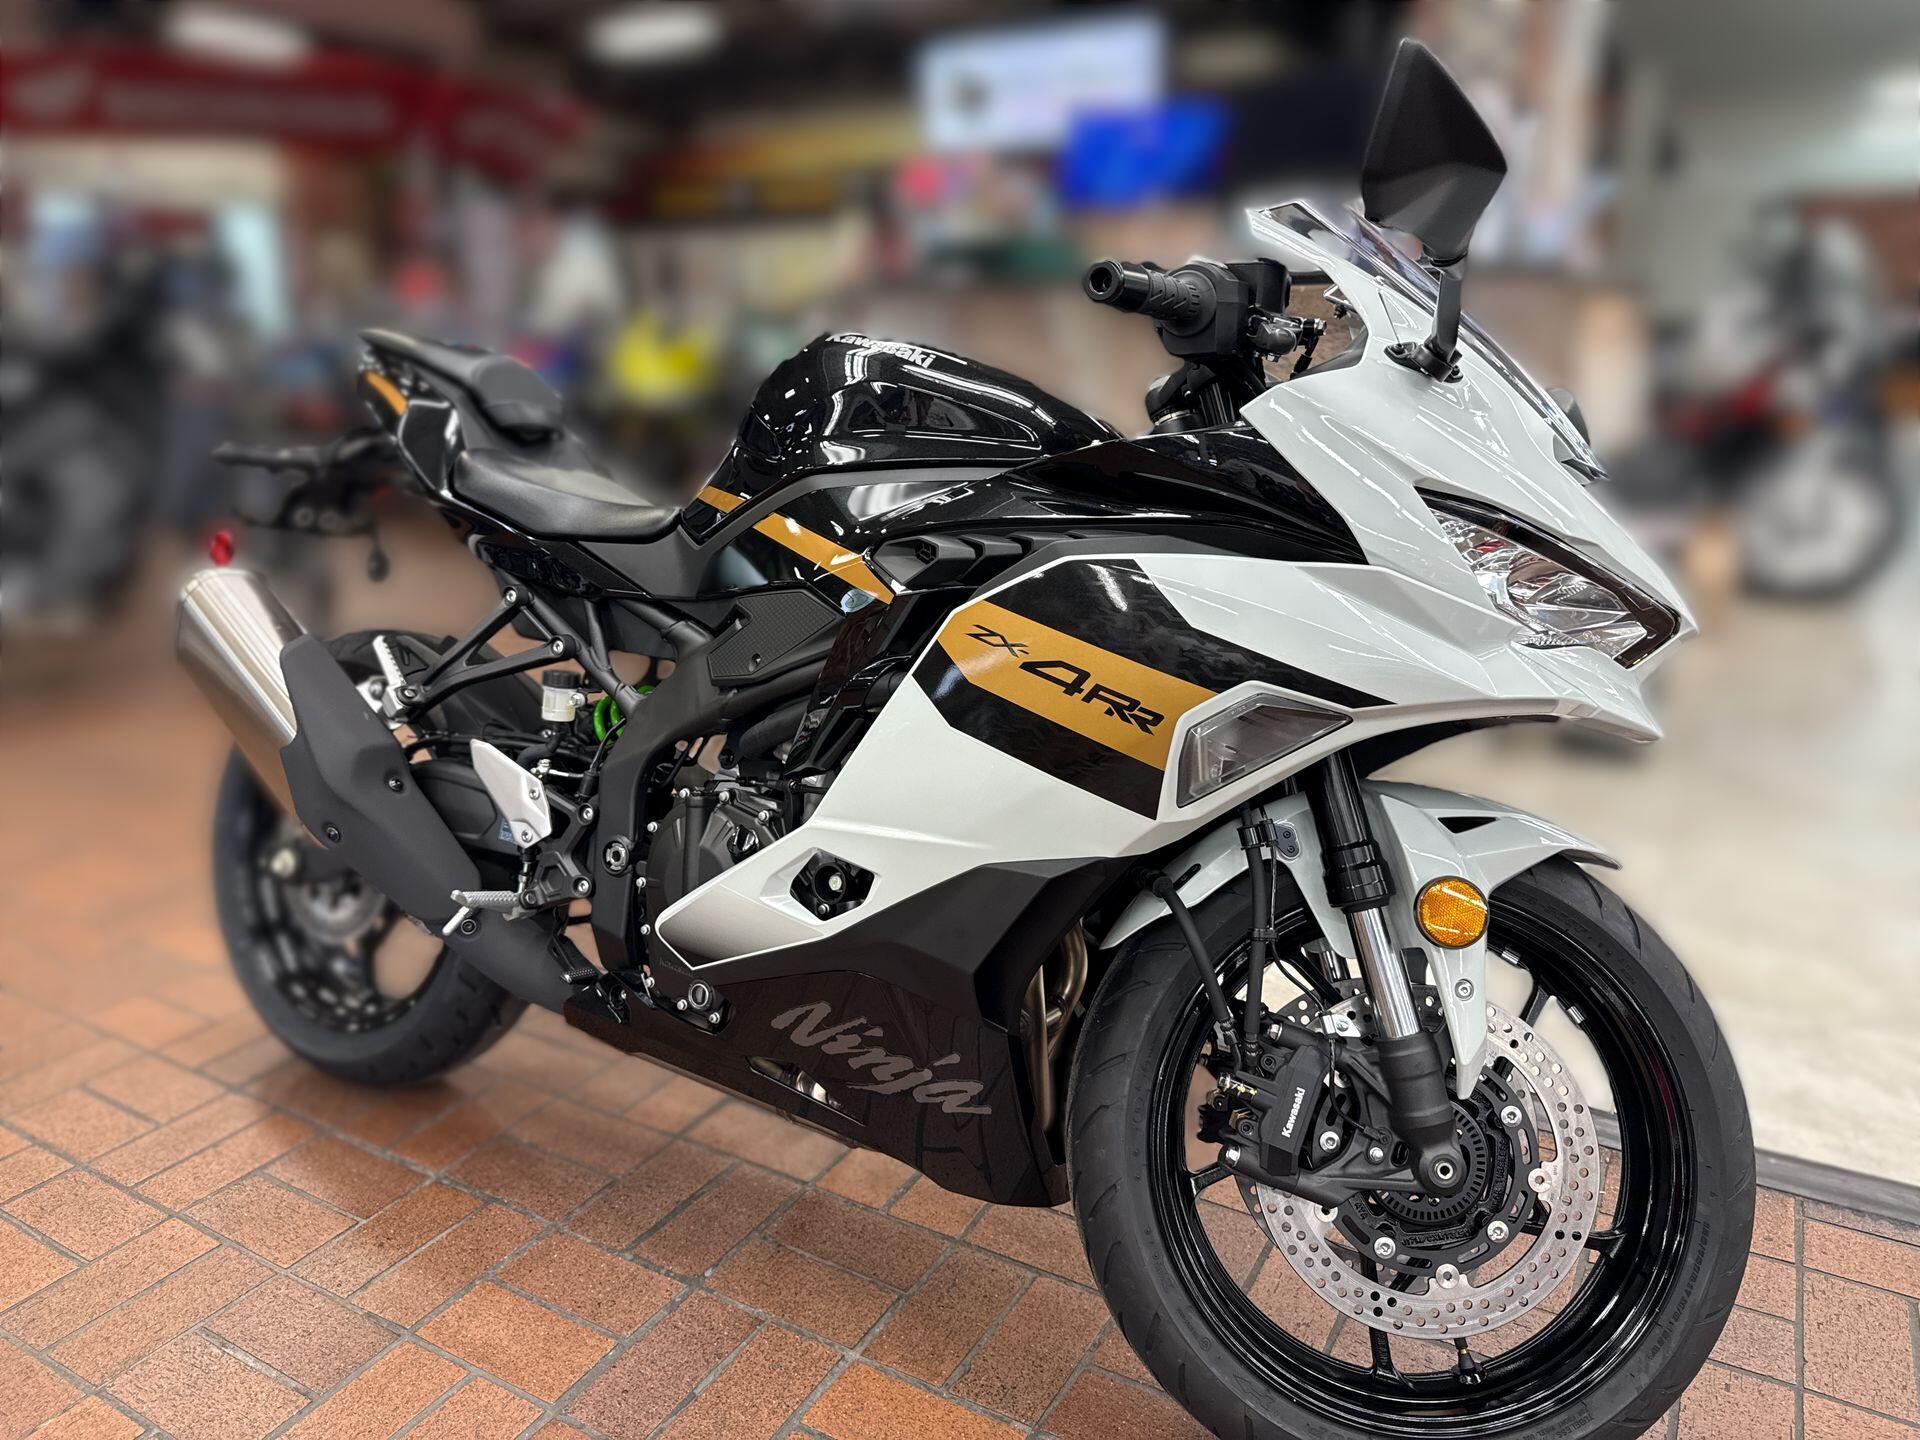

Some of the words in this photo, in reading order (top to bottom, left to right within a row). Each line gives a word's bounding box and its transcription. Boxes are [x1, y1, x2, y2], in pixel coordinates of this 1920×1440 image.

[770, 1001, 992, 1115] Ninja
[1281, 1086, 1306, 1138] Kawasaki
[1555, 1412, 1594, 1438] TUBELESS
